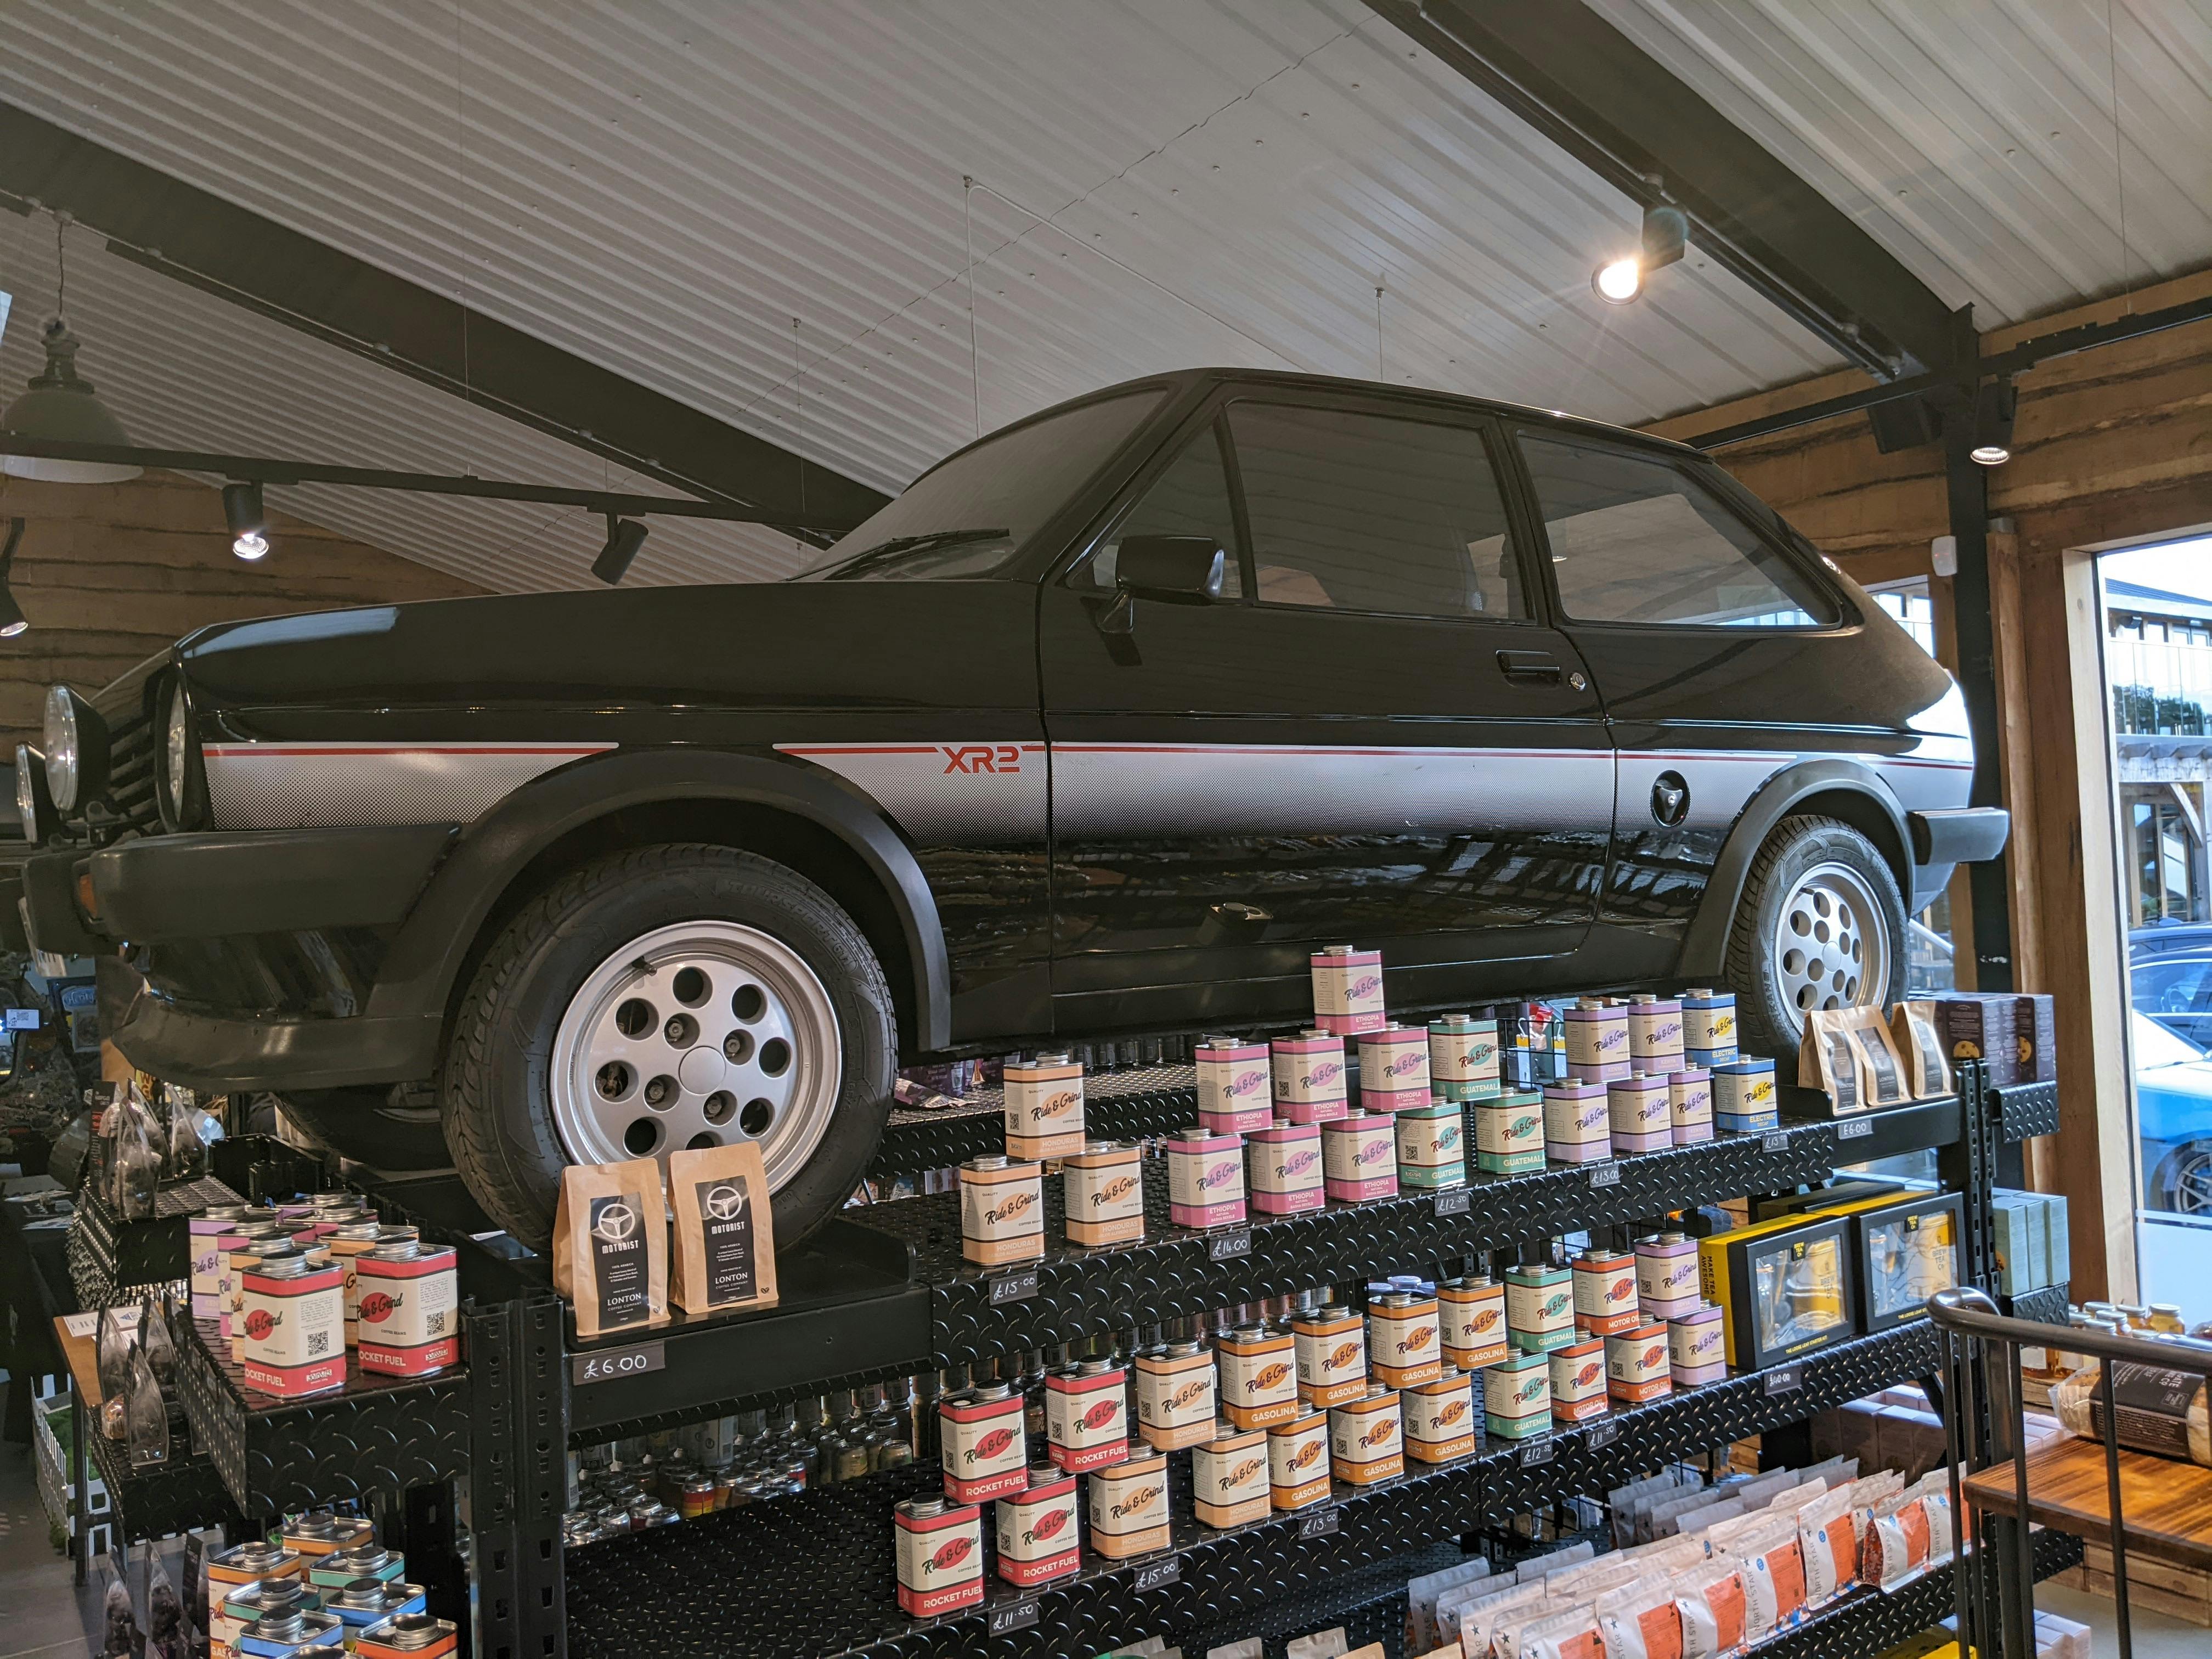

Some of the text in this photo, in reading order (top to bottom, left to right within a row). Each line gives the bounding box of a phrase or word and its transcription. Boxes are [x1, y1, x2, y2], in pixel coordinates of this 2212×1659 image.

[941, 746, 1020, 774] XR2
[1712, 1049, 1736, 1059] ELECTRIC
[1031, 1088, 1082, 1121] Ride & Grind
[1313, 1103, 1339, 1111] ETHIOPIA
[1236, 1113, 1262, 1122] ETHIOPIA
[1749, 1113, 1776, 1124] ELECTRIC
[1843, 1122, 1866, 1135] £6.00
[1042, 1137, 1079, 1147] HONDURAS
[1276, 1147, 1320, 1179] Ride & Grind
[1364, 1180, 1389, 1189] ETHIOPIA
[1288, 1192, 1314, 1201] ETHIOPIA
[1437, 1196, 1466, 1212] £12.50
[985, 1188, 1040, 1225] Ride & Grind
[1209, 1204, 1236, 1214] ETHIOPIA
[712, 1221, 745, 1235] MOTORIST
[1102, 1221, 1138, 1233] HONDURAS
[602, 1240, 639, 1254] MOTORIST
[996, 1239, 1036, 1251] HONDURAS
[1212, 1240, 1248, 1257] £14.00
[715, 1272, 748, 1284] LONTON
[1662, 1275, 1678, 1289] Ride
[1701, 1255, 1709, 1295] AWESOME
[994, 1277, 1035, 1301] £15.00
[607, 1293, 641, 1306] LONTON
[1462, 1307, 1503, 1336] Ride & Grind
[1608, 1318, 1630, 1329] MOTOR
[359, 1351, 407, 1367] OCKET FUEL
[1467, 1347, 1504, 1363] GASOLINA
[584, 1355, 647, 1379] £6.00
[1401, 1366, 1439, 1382] GASOLINA
[246, 1369, 286, 1387] OCKET FUEL
[1245, 1358, 1294, 1394] Ride & Grind
[1161, 1375, 1211, 1413] Ride & Grind
[1327, 1383, 1365, 1400] GASOLINA
[1639, 1385, 1658, 1396] MOTOR
[1073, 1395, 1124, 1435] Ride & Grind
[1251, 1408, 1296, 1423] GASOLINA
[1173, 1425, 1208, 1438] HONDURAS
[1589, 1425, 1614, 1447] £11.50
[964, 1422, 1022, 1465] Ride & Grind
[1435, 1440, 1472, 1457] GASOLINA
[1075, 1447, 1127, 1465] ROCKET FUEL
[1523, 1444, 1551, 1463] £12.50
[1363, 1460, 1402, 1477] GASOLINA
[966, 1476, 1025, 1497] ROCKET FUEL
[1291, 1482, 1328, 1501] GASOLINA
[1110, 1481, 1165, 1520] Ride & Grind
[1229, 1502, 1265, 1515] HONDURAS
[1022, 1506, 1075, 1546] Ride & Grind
[1302, 1514, 1336, 1535] £13.00
[1122, 1532, 1161, 1545] HONDURAS
[922, 1530, 980, 1575] Ride & Grind
[1023, 1556, 1078, 1578] ROCKET FUEL
[1136, 1563, 1176, 1589] £15.00
[923, 1585, 983, 1608] ROCKET FUEL
[1746, 1570, 1759, 1632] NORTH STAR
[994, 1605, 1033, 1630] £11.50
